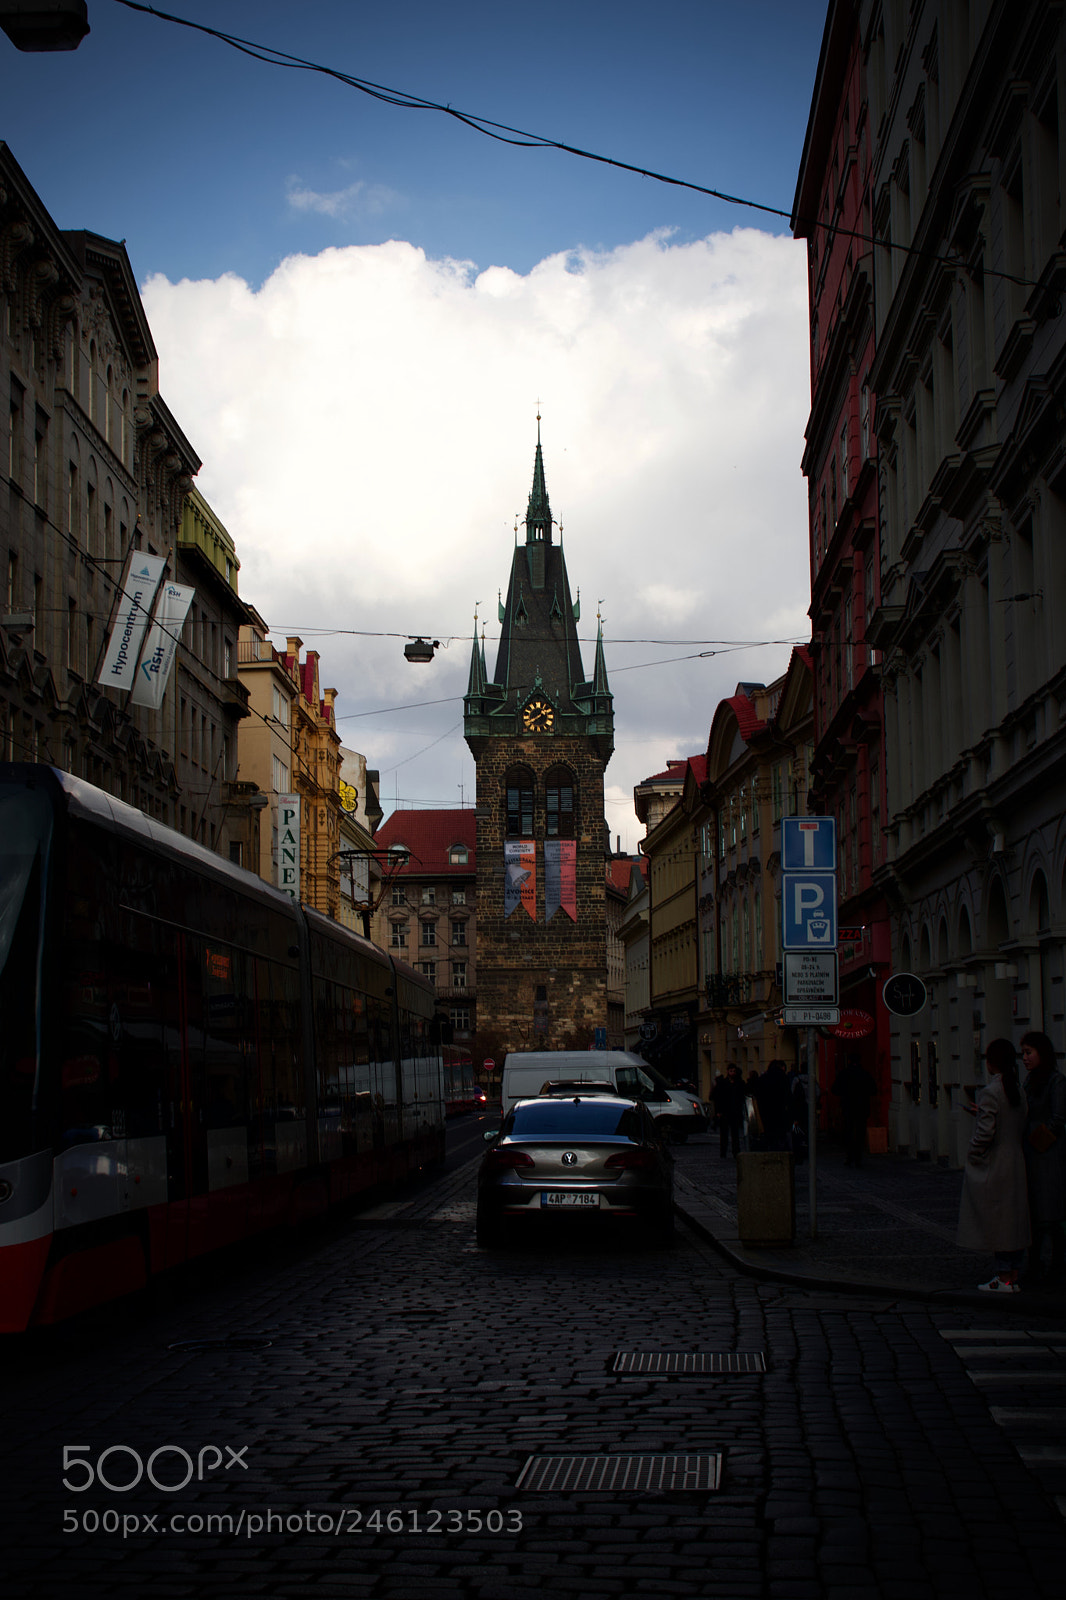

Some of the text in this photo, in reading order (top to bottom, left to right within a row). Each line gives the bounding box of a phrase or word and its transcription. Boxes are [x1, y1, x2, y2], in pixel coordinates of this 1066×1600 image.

[111, 591, 143, 675] Hypocentrum
[149, 647, 165, 673] RSH
[794, 882, 825, 925] P
[838, 929, 861, 940] ZZA
[835, 1026, 868, 1038] PIZZERIA
[548, 1194, 595, 1204] 4AP 7184
